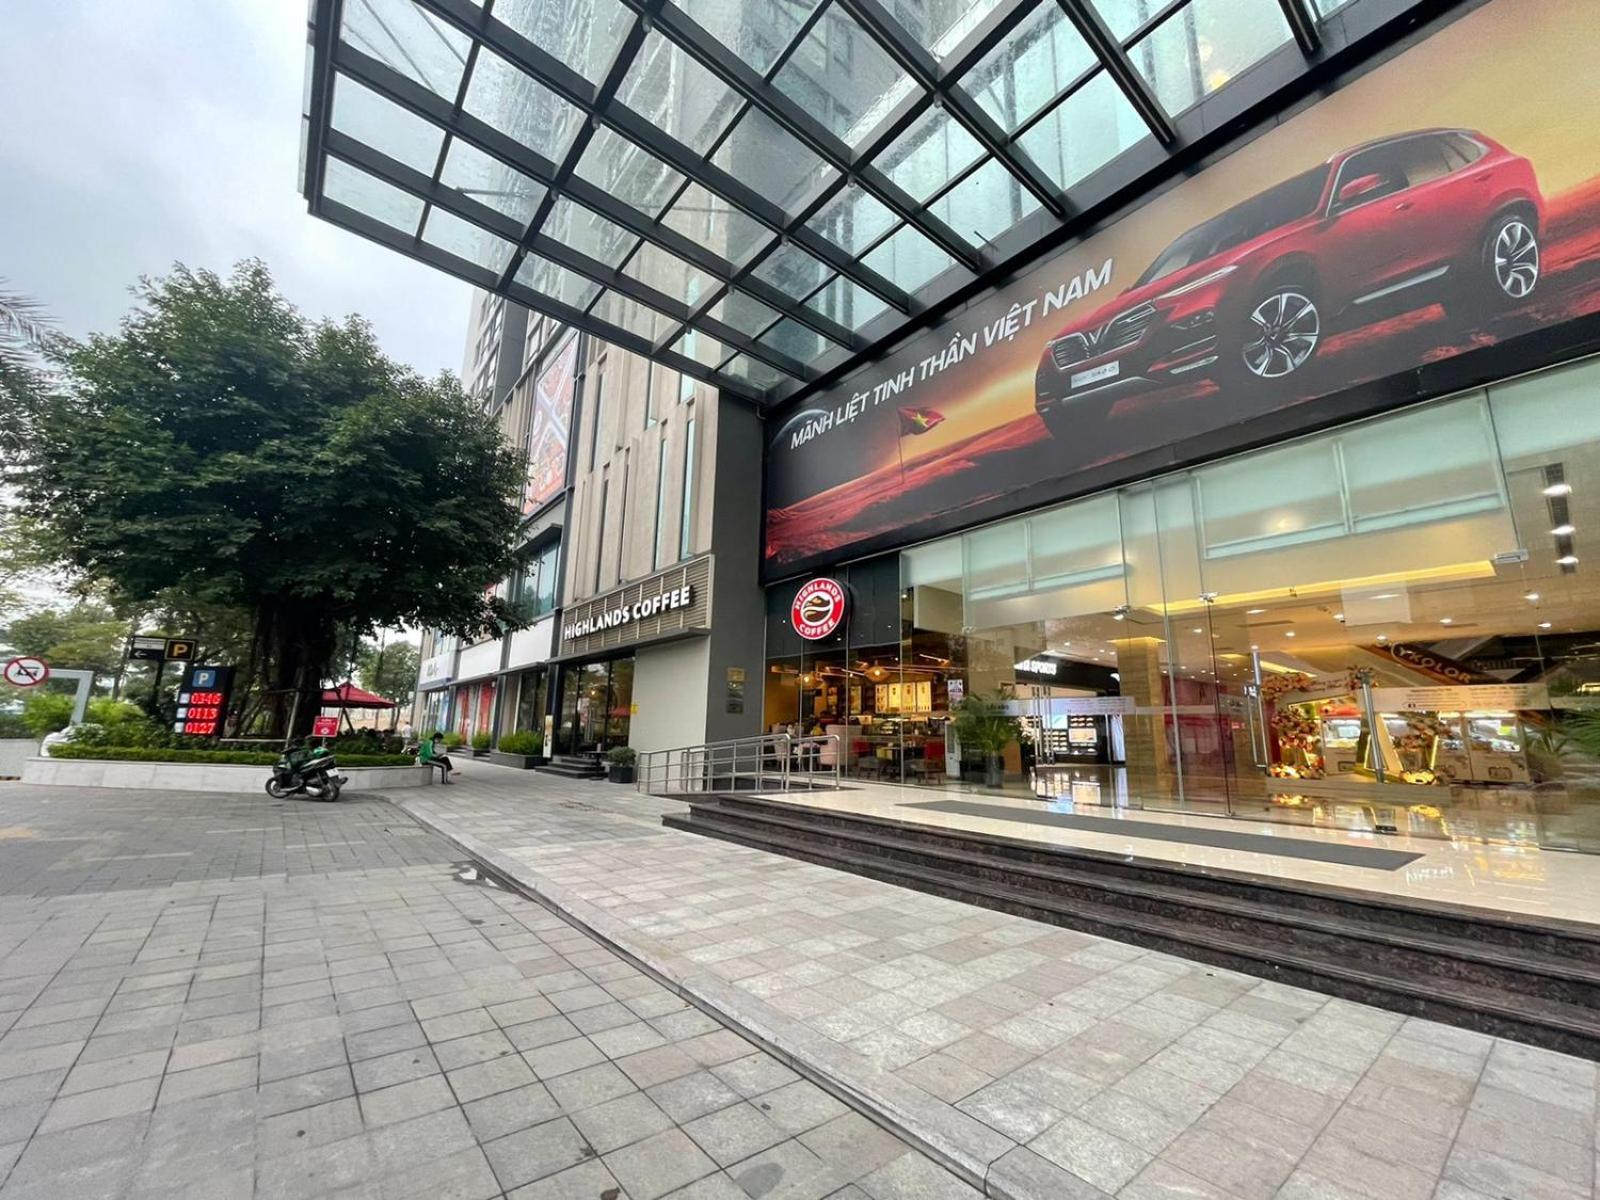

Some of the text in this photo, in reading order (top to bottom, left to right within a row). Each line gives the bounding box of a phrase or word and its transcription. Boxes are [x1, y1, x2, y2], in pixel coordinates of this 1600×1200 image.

[790, 257, 1113, 450] MÃNH LIỆT TINH THẦN VIỆT NAM
[796, 582, 841, 610] HIGHLANDS
[563, 585, 690, 640] HIGHLANDS COFFEE
[799, 618, 835, 636] COFFEE
[173, 644, 188, 657] P
[198, 673, 209, 685] P
[187, 707, 219, 720] 0113
[184, 722, 216, 735] 0127
